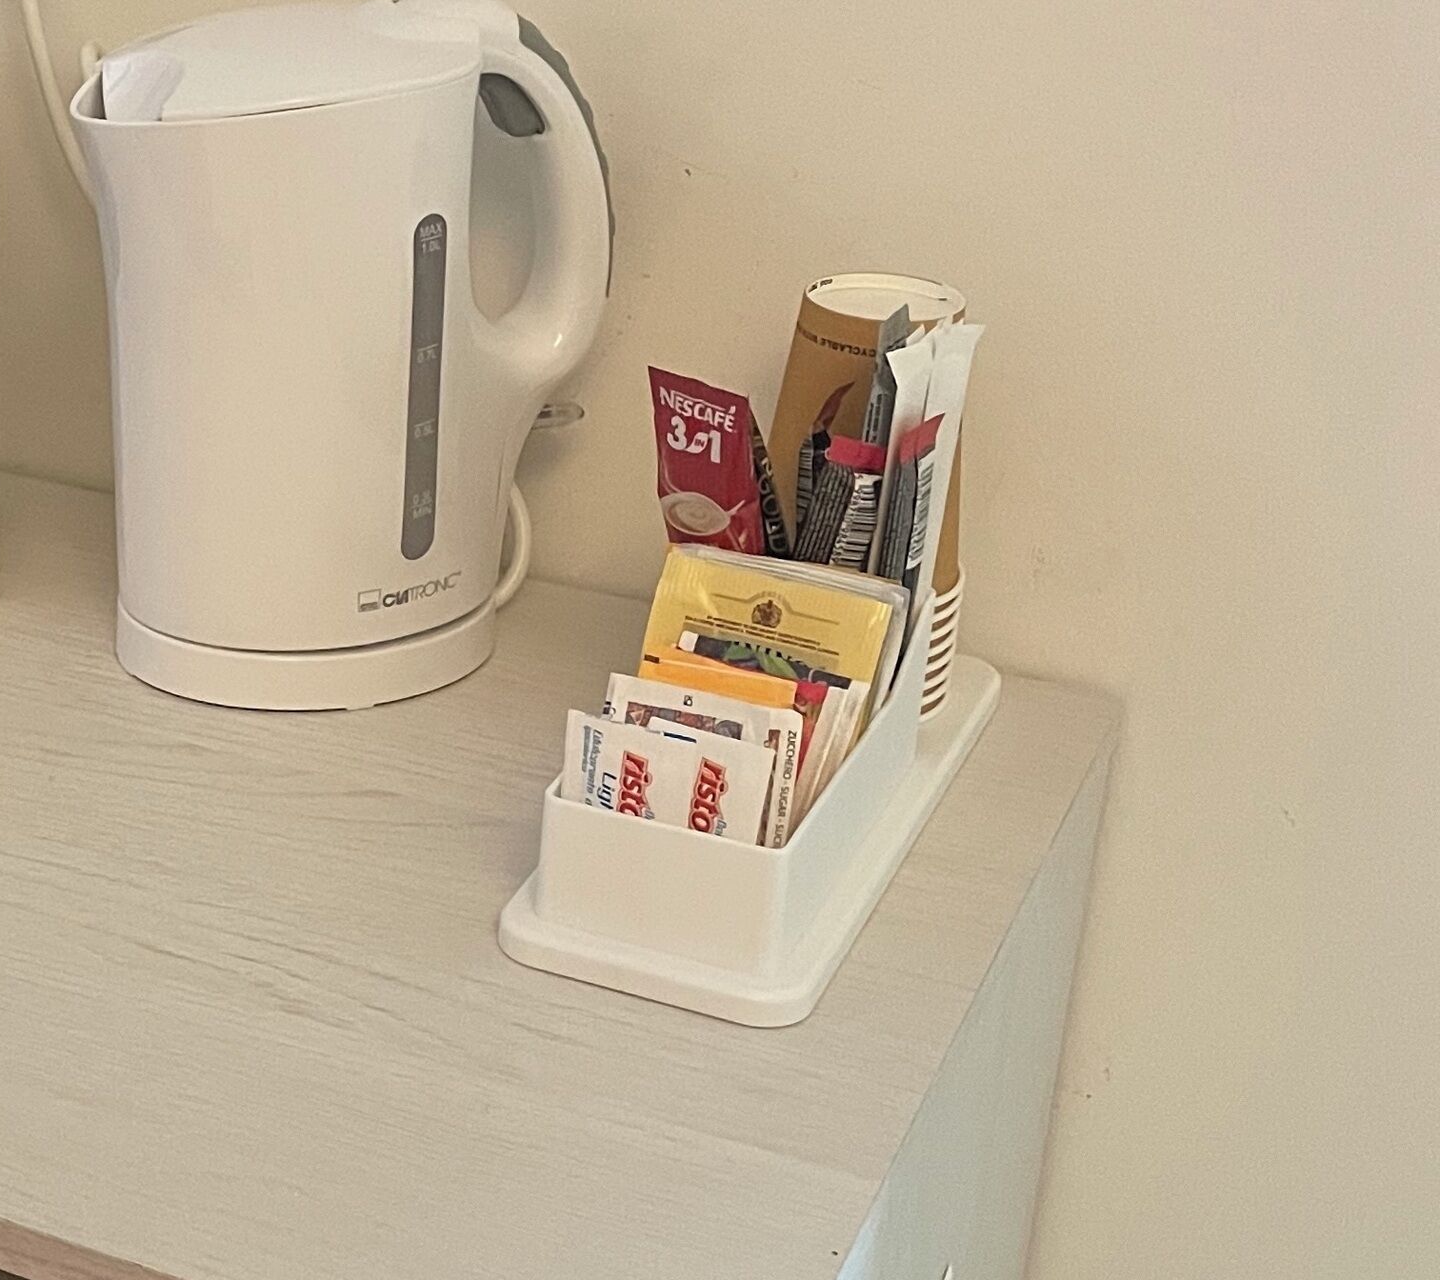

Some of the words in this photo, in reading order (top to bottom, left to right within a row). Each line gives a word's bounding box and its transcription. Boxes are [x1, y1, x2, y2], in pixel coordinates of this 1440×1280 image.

[659, 386, 736, 433] NESCAFÉ
[780, 730, 797, 780] ZUCCHERO
[777, 787, 790, 824] SUGAR
